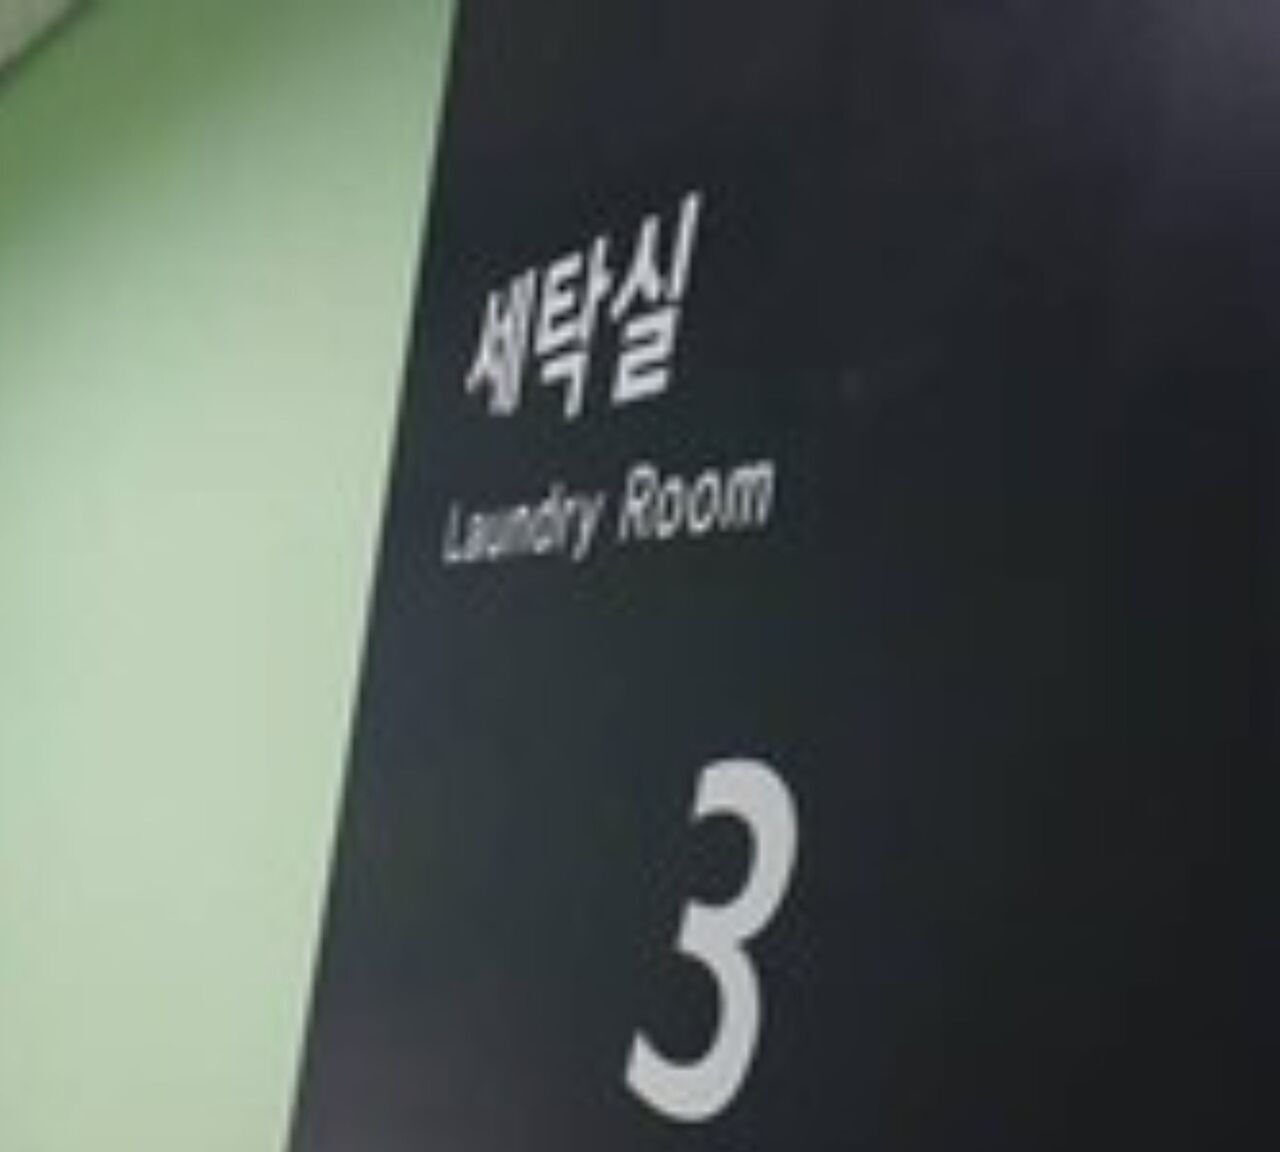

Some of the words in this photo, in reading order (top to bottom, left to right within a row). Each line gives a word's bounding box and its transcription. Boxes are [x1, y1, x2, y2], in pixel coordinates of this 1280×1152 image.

[465, 192, 701, 420] 세탁실
[442, 484, 605, 564] Laundry
[620, 459, 775, 542] Room
[625, 757, 799, 1123] 3
